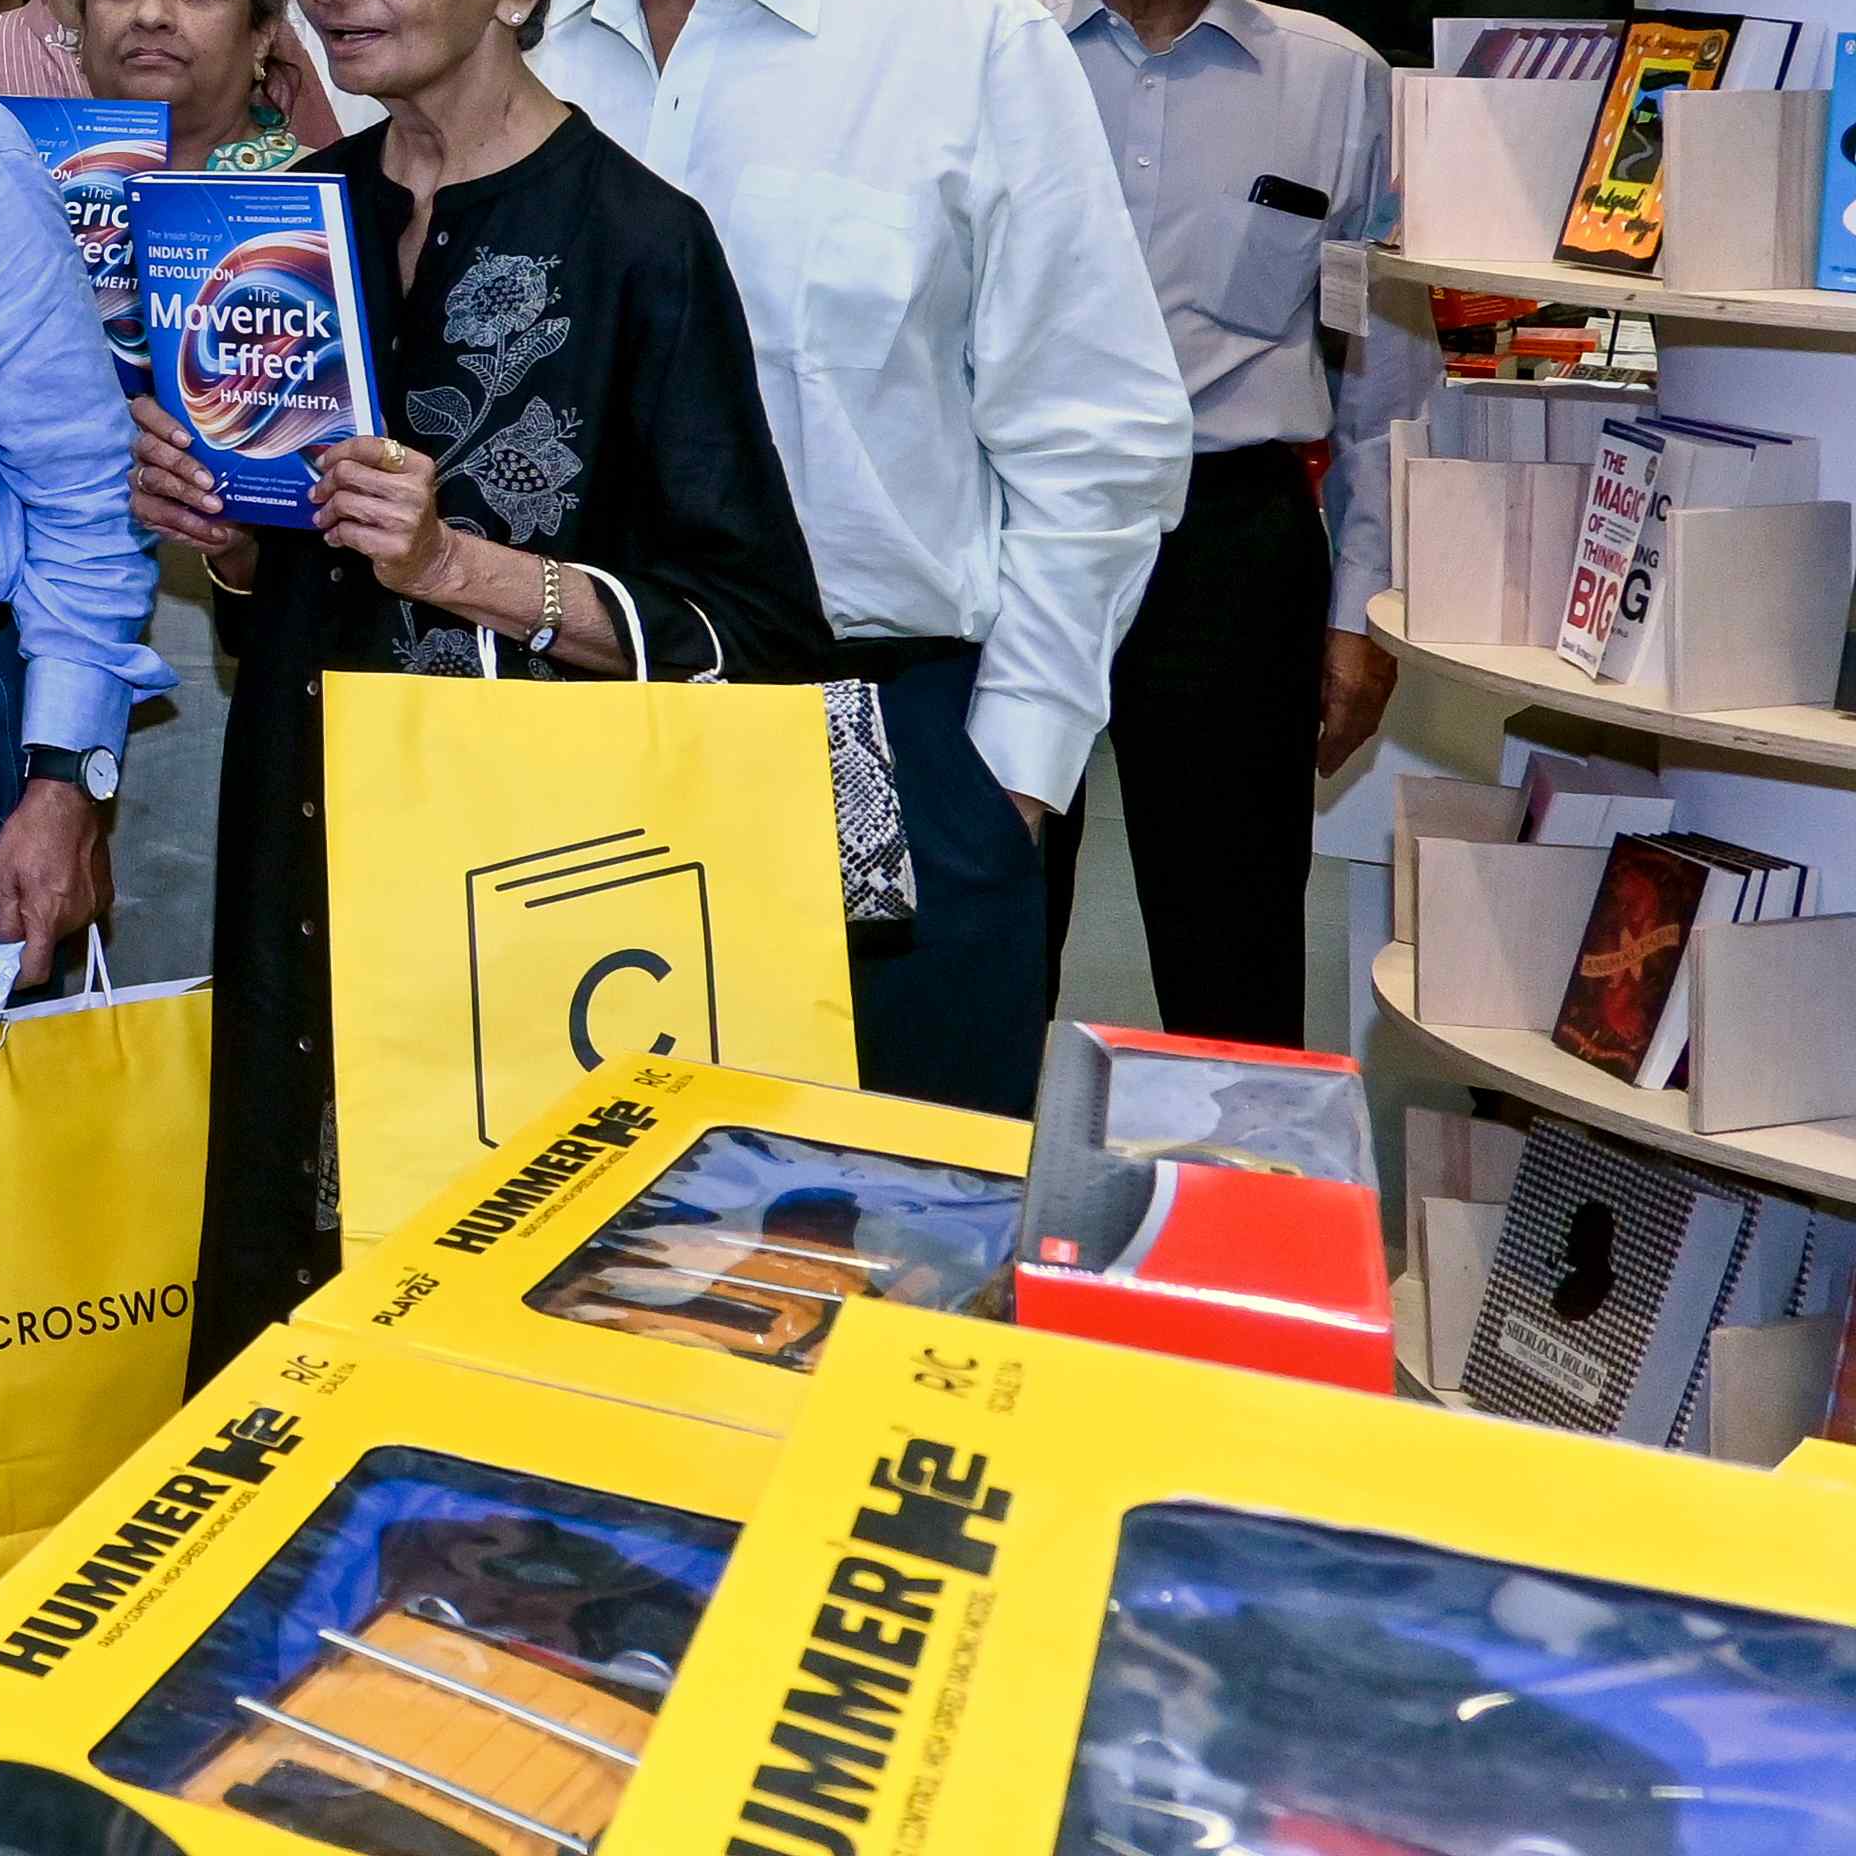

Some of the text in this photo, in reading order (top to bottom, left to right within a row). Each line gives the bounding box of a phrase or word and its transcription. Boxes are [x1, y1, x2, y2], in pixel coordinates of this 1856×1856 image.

[148, 292, 331, 338] Maverick
[217, 343, 317, 382] Effect
[221, 390, 340, 411] HARISH MEHTA
[1603, 448, 1628, 475] THE
[1592, 475, 1647, 524] MAGIC
[1588, 512, 1606, 533] OF
[1582, 537, 1629, 579] THINKING
[1566, 565, 1620, 642] BIG
[633, 1067, 673, 1089] R/C
[433, 1138, 606, 1255] HUMMER
[280, 1354, 329, 1386] R/C
[1504, 1319, 1559, 1364] SHERLOCK
[1560, 1350, 1601, 1388] HOLMES
[725, 1554, 945, 1856] UMMER
